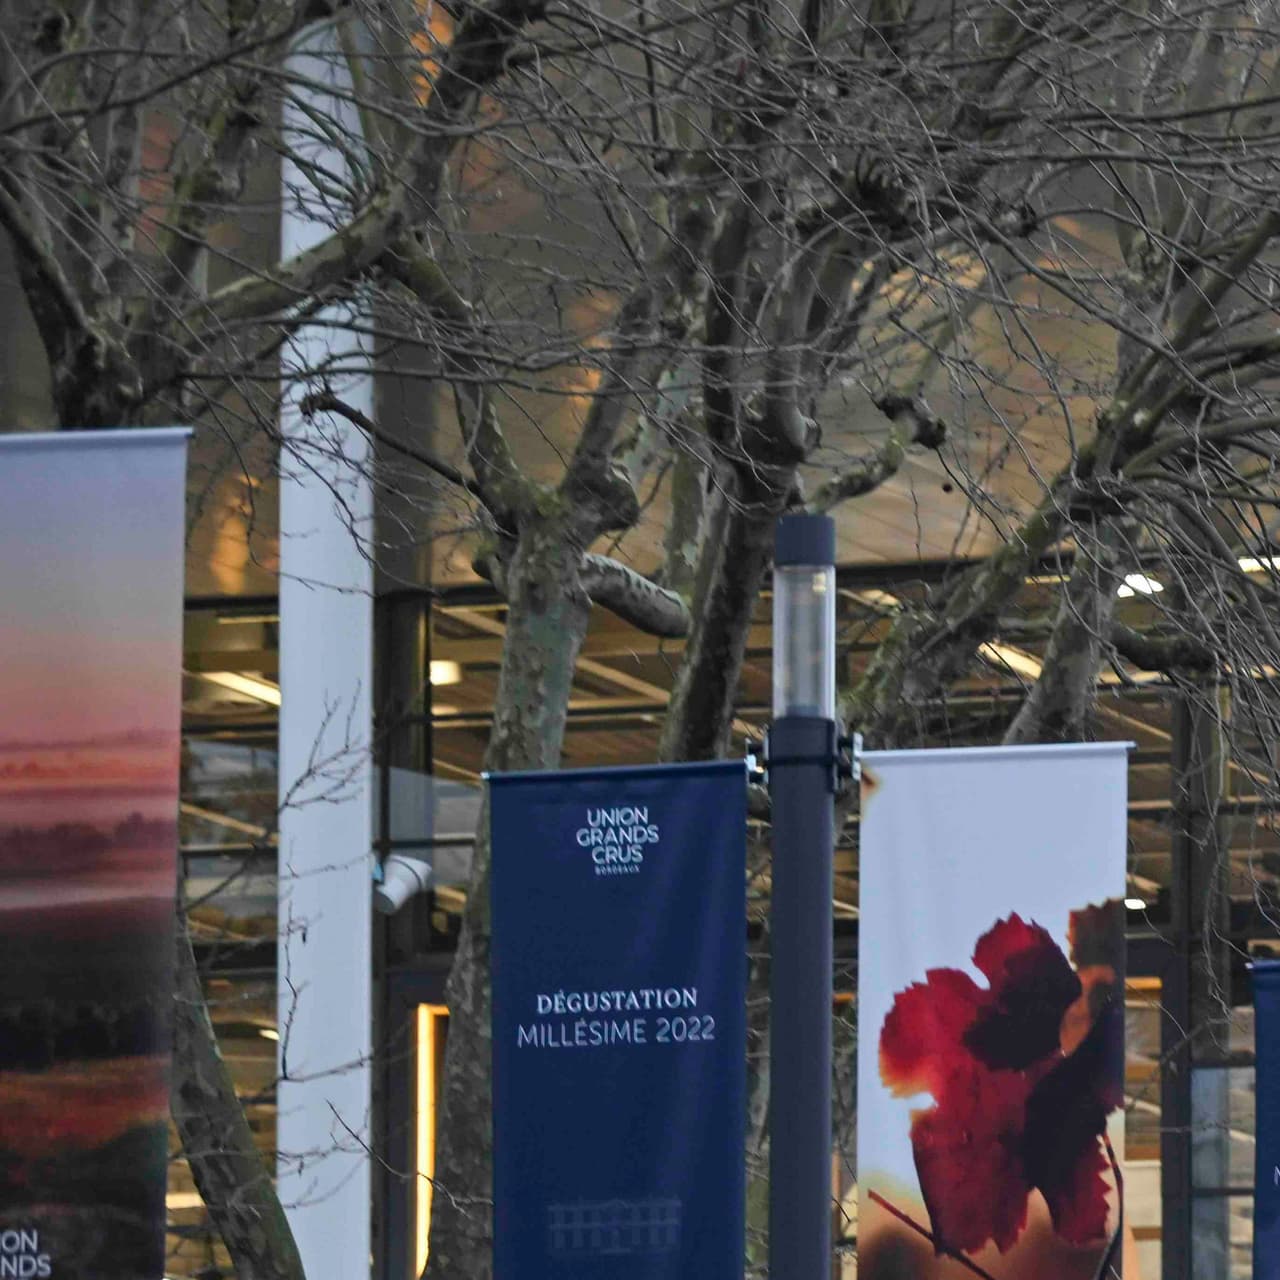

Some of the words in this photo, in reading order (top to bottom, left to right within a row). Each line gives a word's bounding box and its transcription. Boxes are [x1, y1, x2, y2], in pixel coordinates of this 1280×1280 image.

[587, 806, 649, 828] UNION
[576, 824, 660, 847] GRANDS
[592, 843, 644, 864] CRUS
[536, 986, 698, 1015] DÉGUSTATION
[517, 1016, 648, 1049] MILLÉSIME
[655, 1014, 716, 1043] 2022
